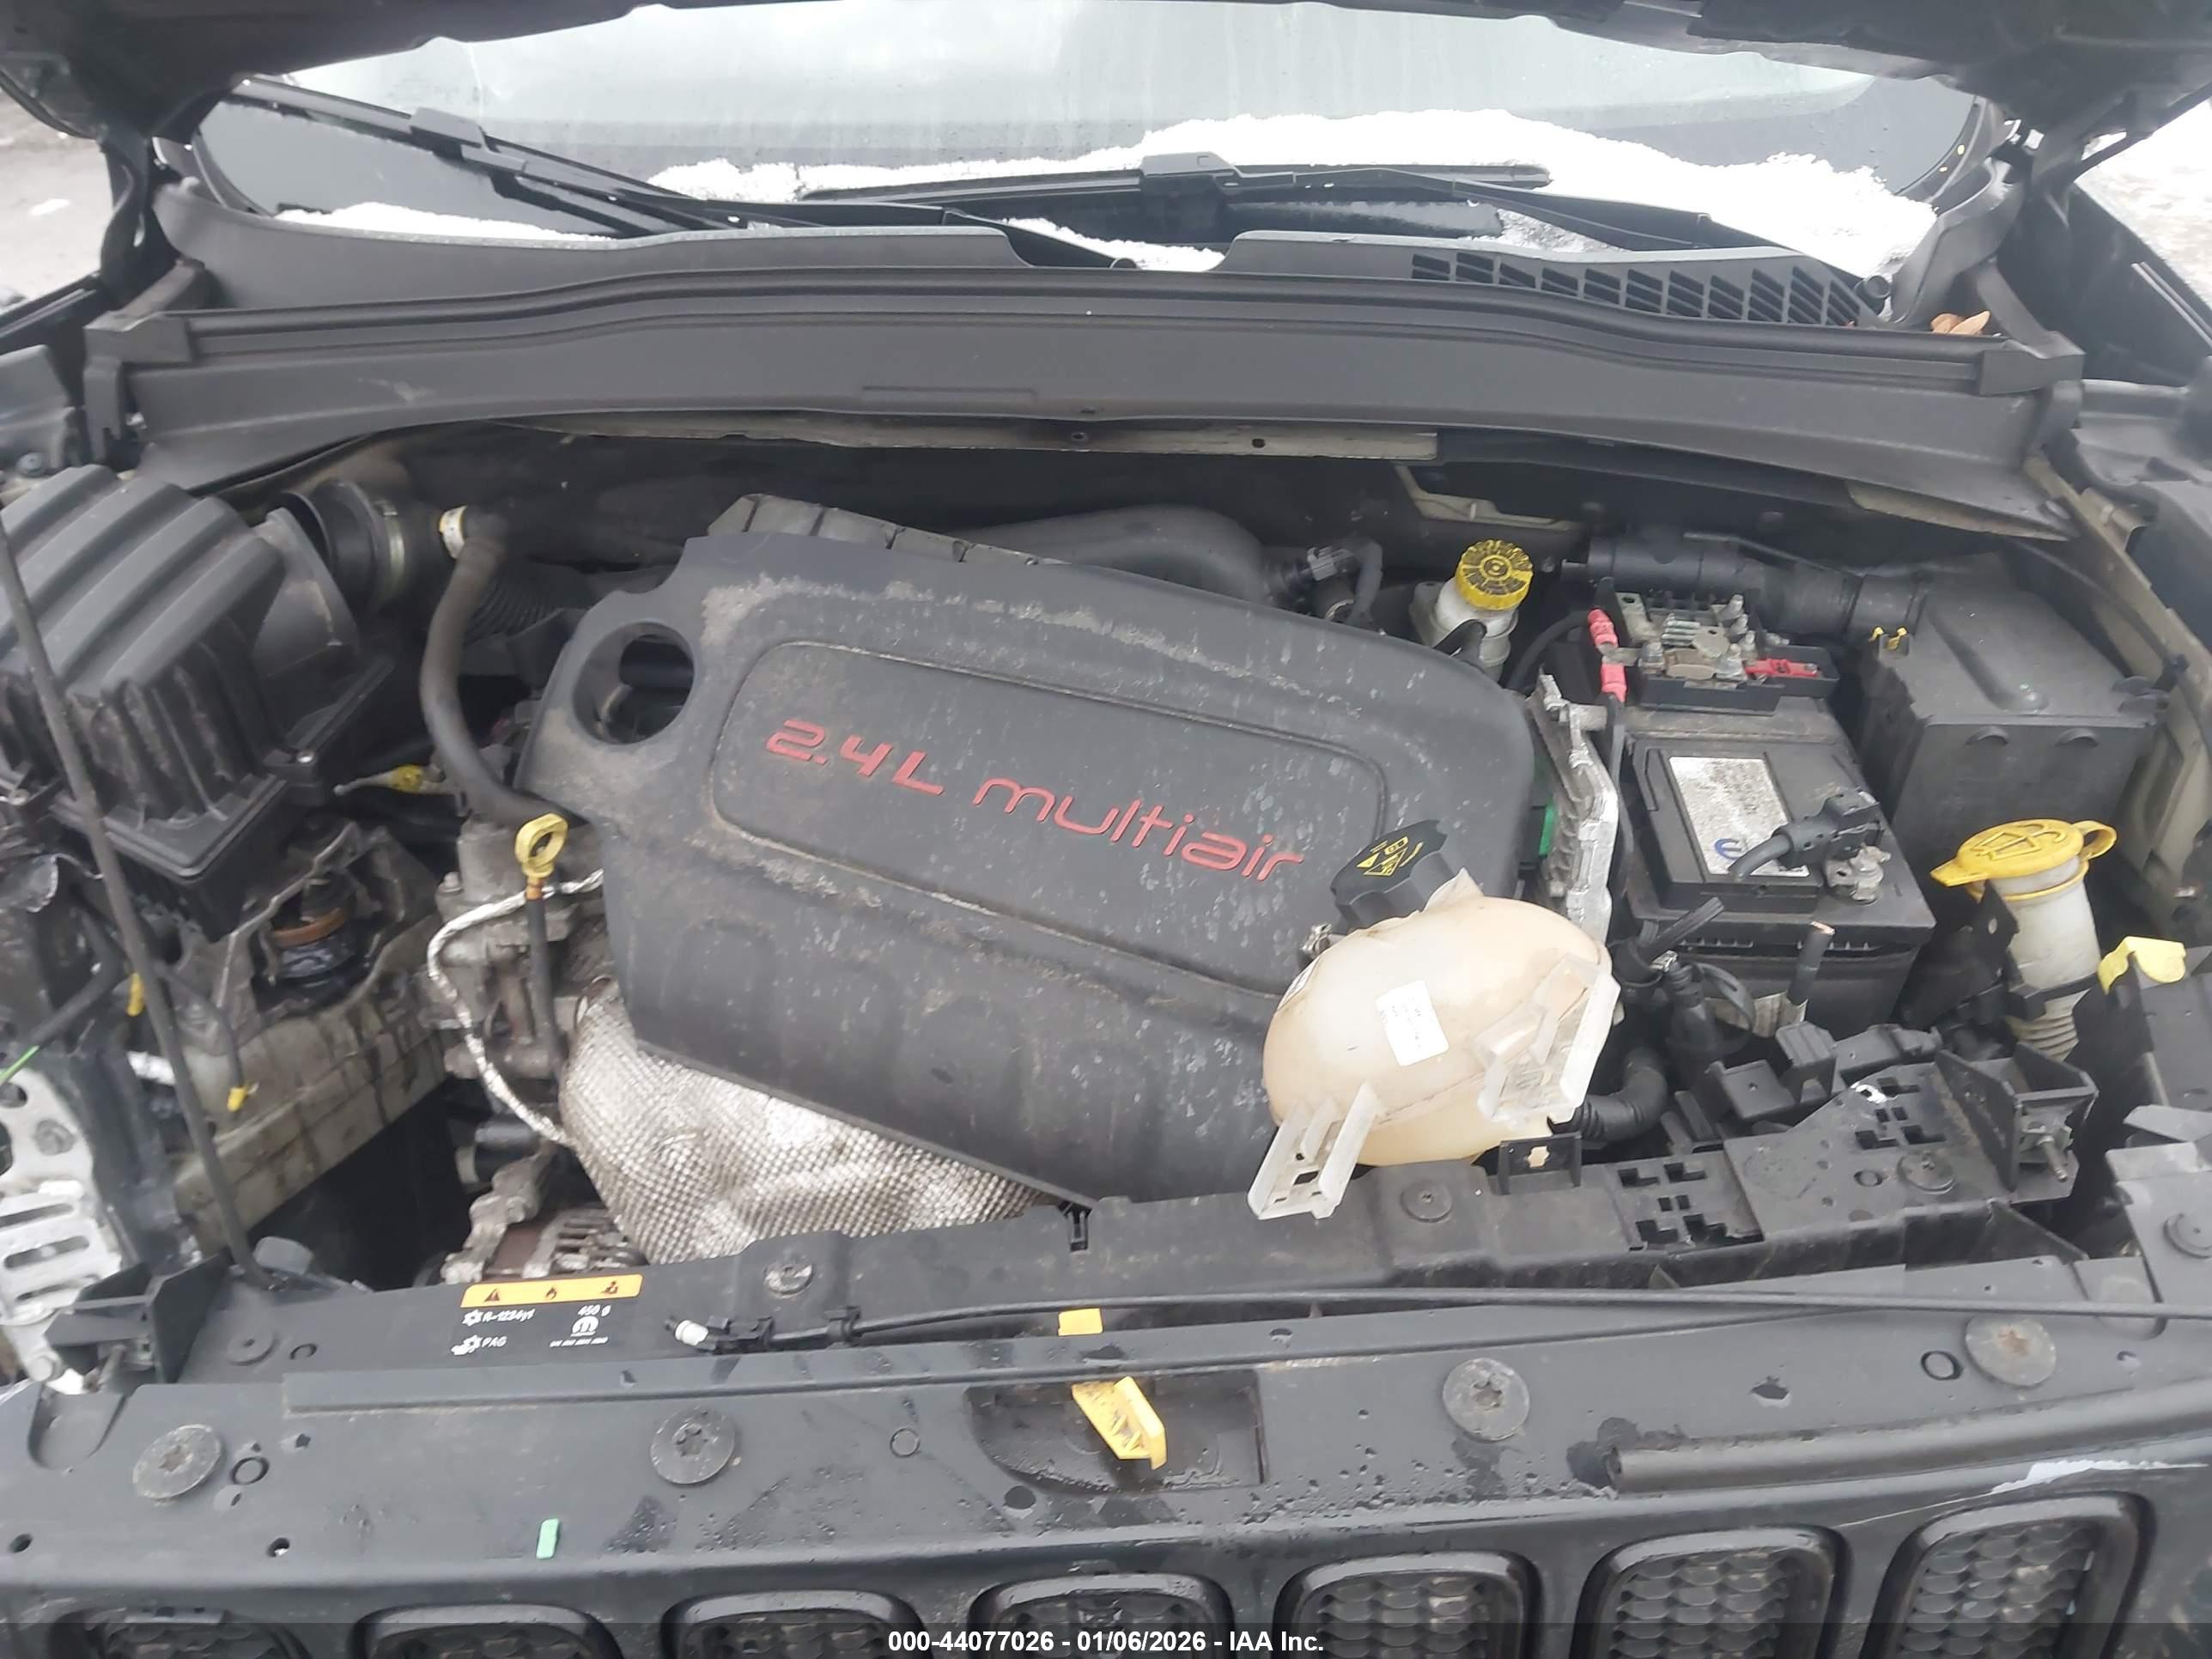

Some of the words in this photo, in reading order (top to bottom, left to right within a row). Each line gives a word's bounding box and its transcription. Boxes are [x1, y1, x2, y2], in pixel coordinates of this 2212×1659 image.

[767, 720, 945, 795] 2.4L
[973, 778, 1304, 882] multiair
[481, 1335, 507, 1348] PAG
